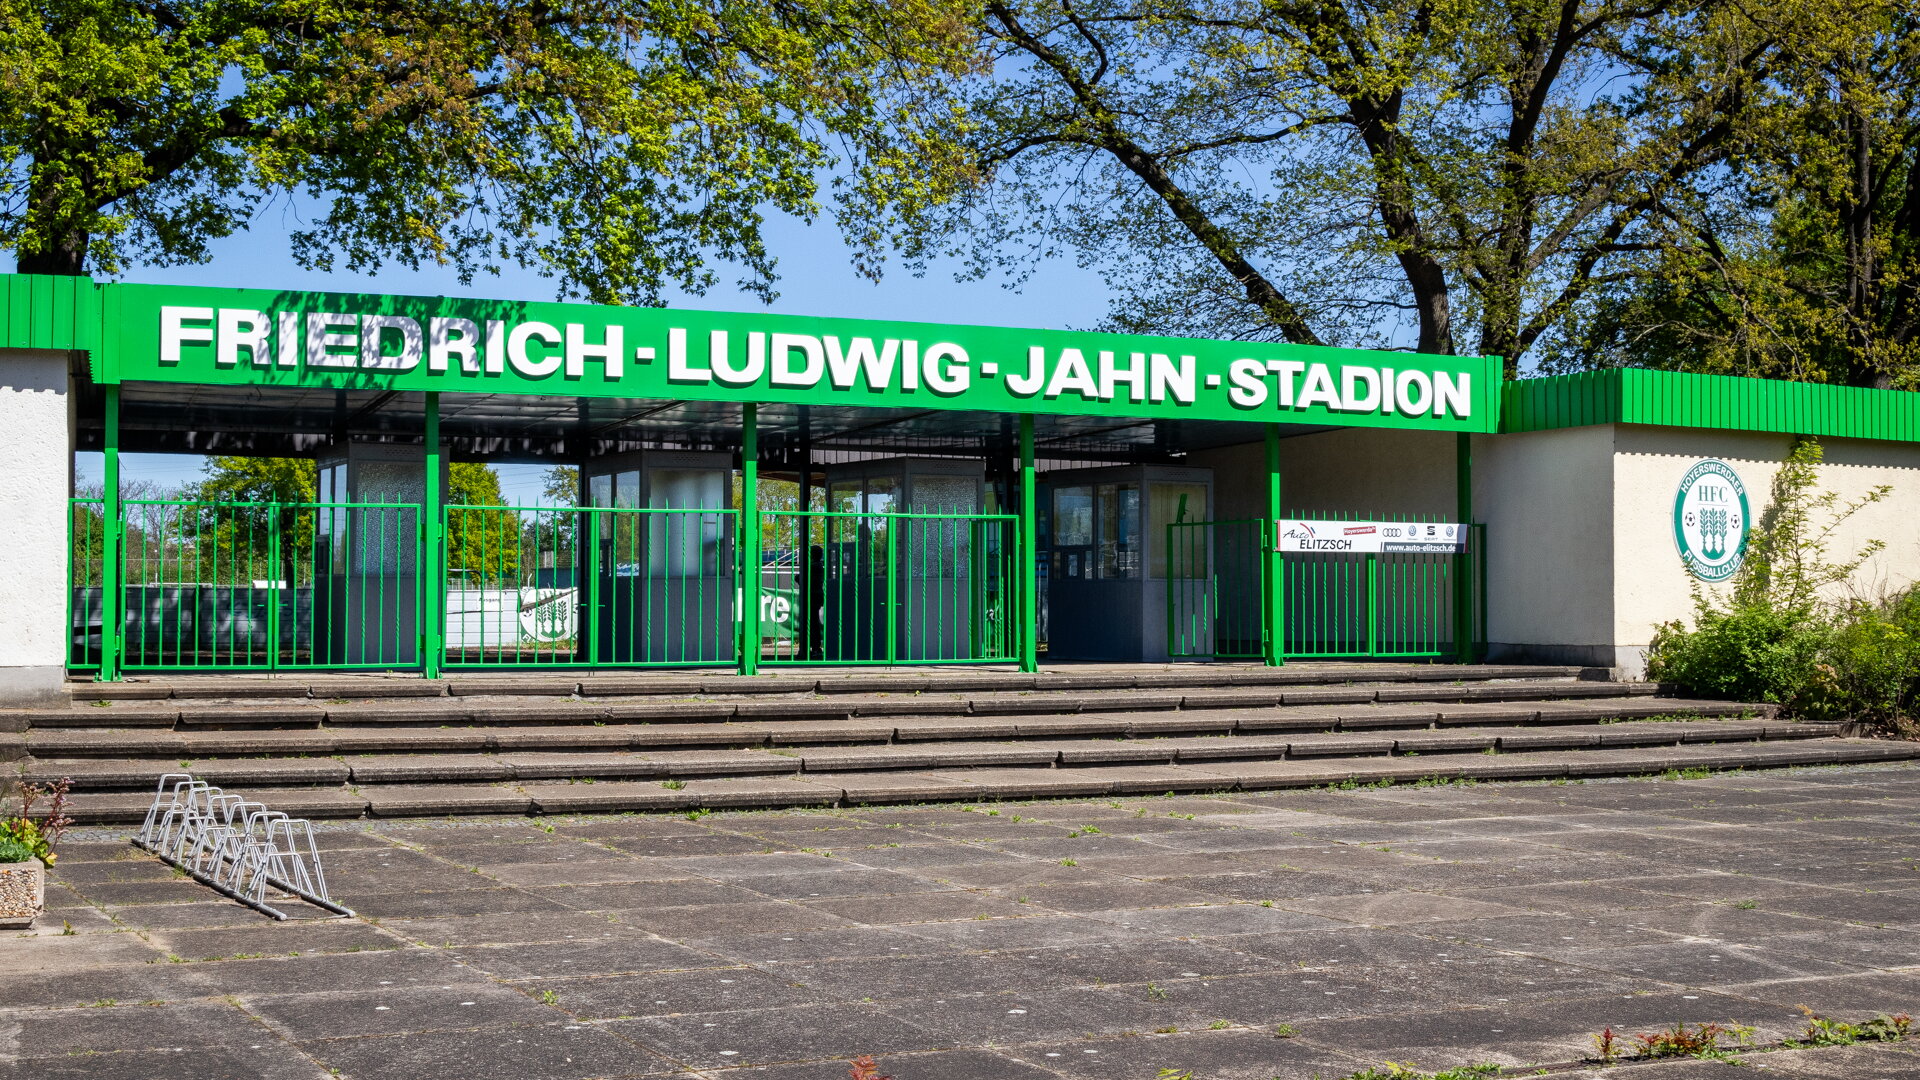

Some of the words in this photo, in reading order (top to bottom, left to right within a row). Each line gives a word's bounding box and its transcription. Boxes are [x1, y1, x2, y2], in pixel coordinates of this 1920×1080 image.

[1681, 462, 1743, 497] HOYERSWERDAER
[1698, 485, 1728, 502] HFC
[1283, 529, 1309, 539] Auto
[1300, 539, 1352, 550] ELITZSCH
[1386, 543, 1456, 552] www.auto-elitzsch.de
